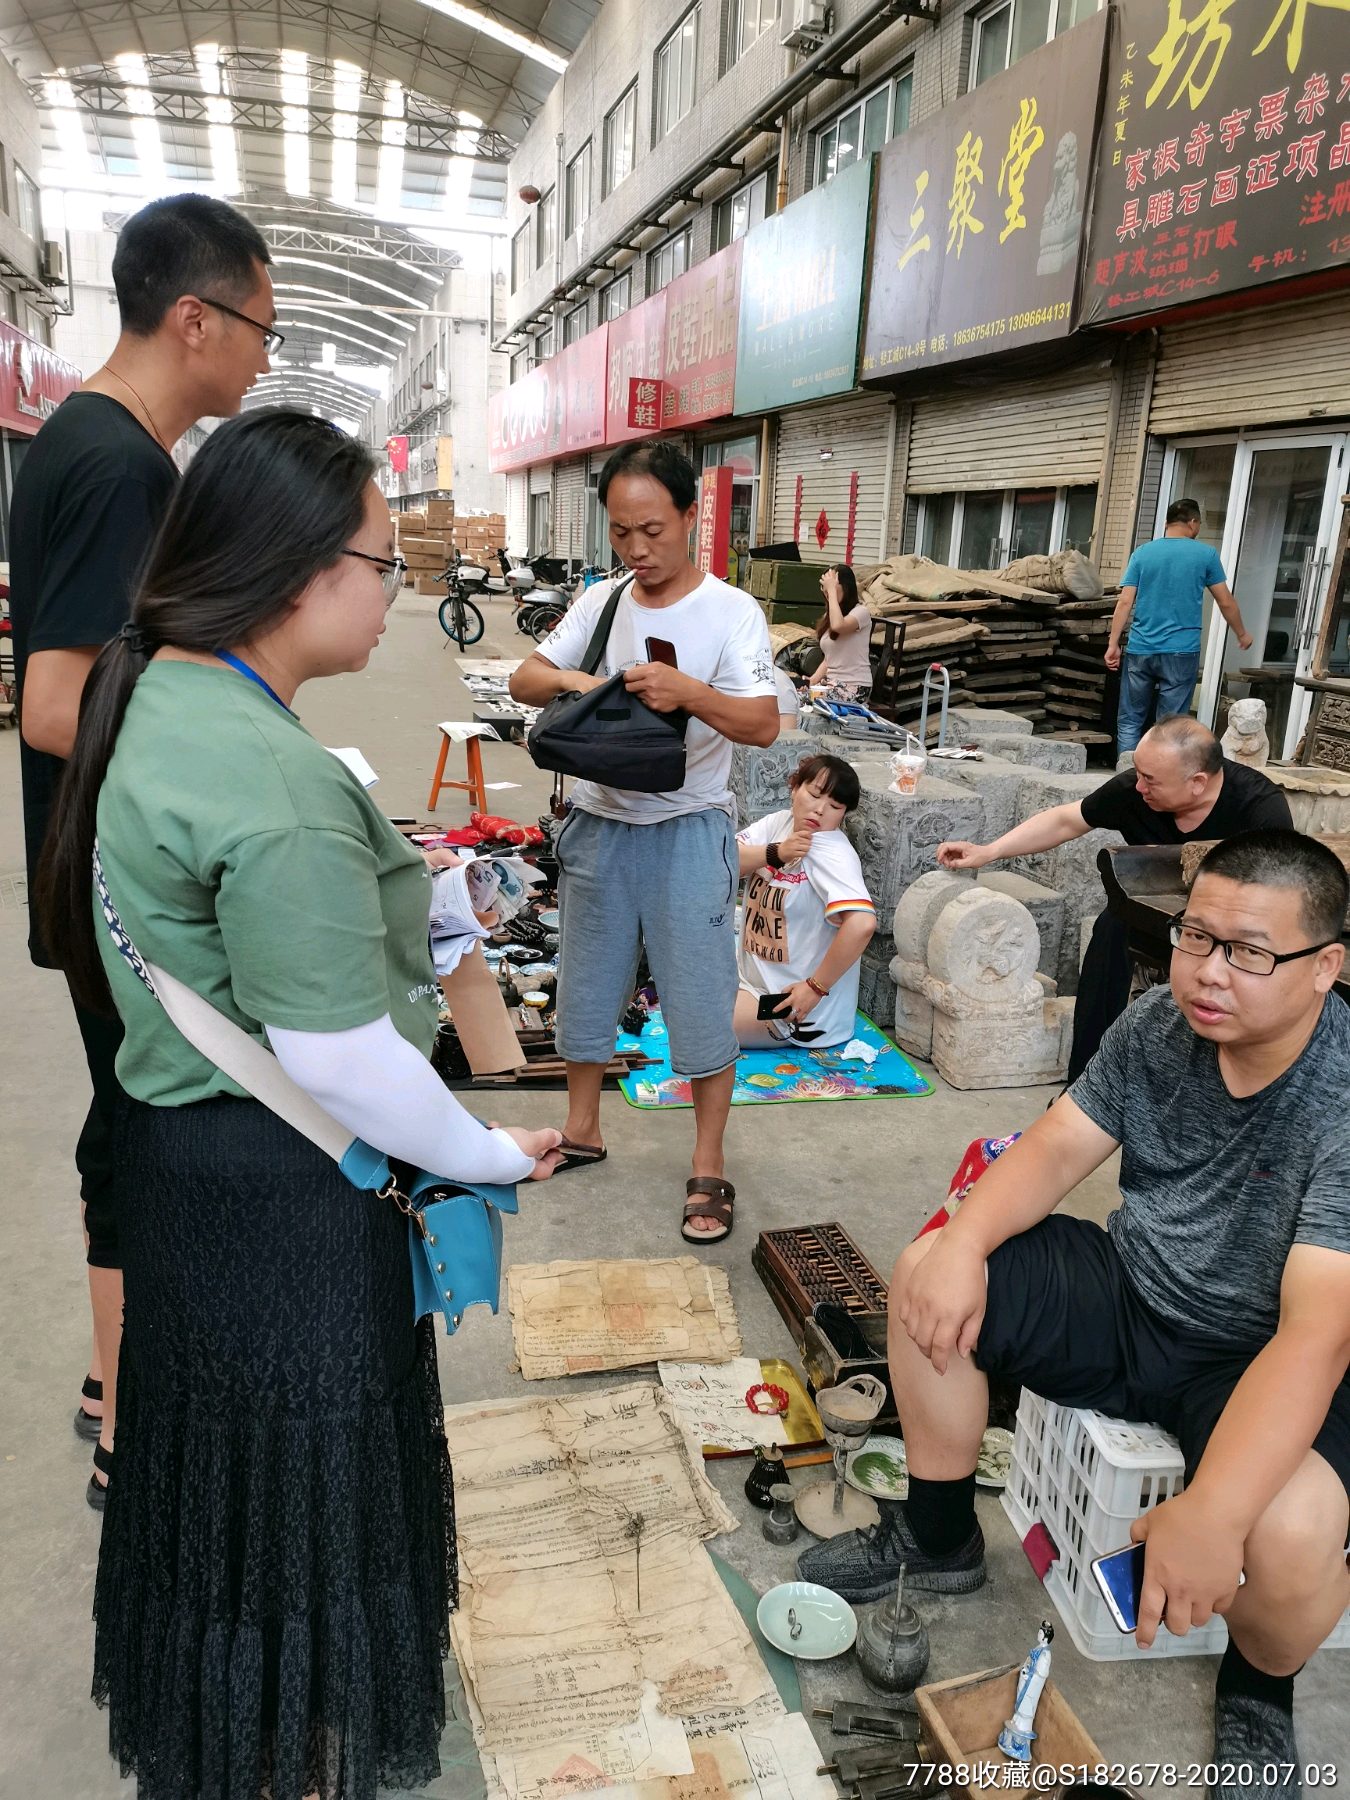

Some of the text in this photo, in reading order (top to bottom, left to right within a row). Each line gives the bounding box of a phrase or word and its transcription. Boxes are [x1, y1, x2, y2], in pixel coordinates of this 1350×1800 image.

[1112, 42, 1138, 166] 乙未年夏日
[897, 97, 1045, 272] 三聚堂
[1008, 301, 1071, 333] 13096644131
[634, 381, 657, 427] 修鞋
